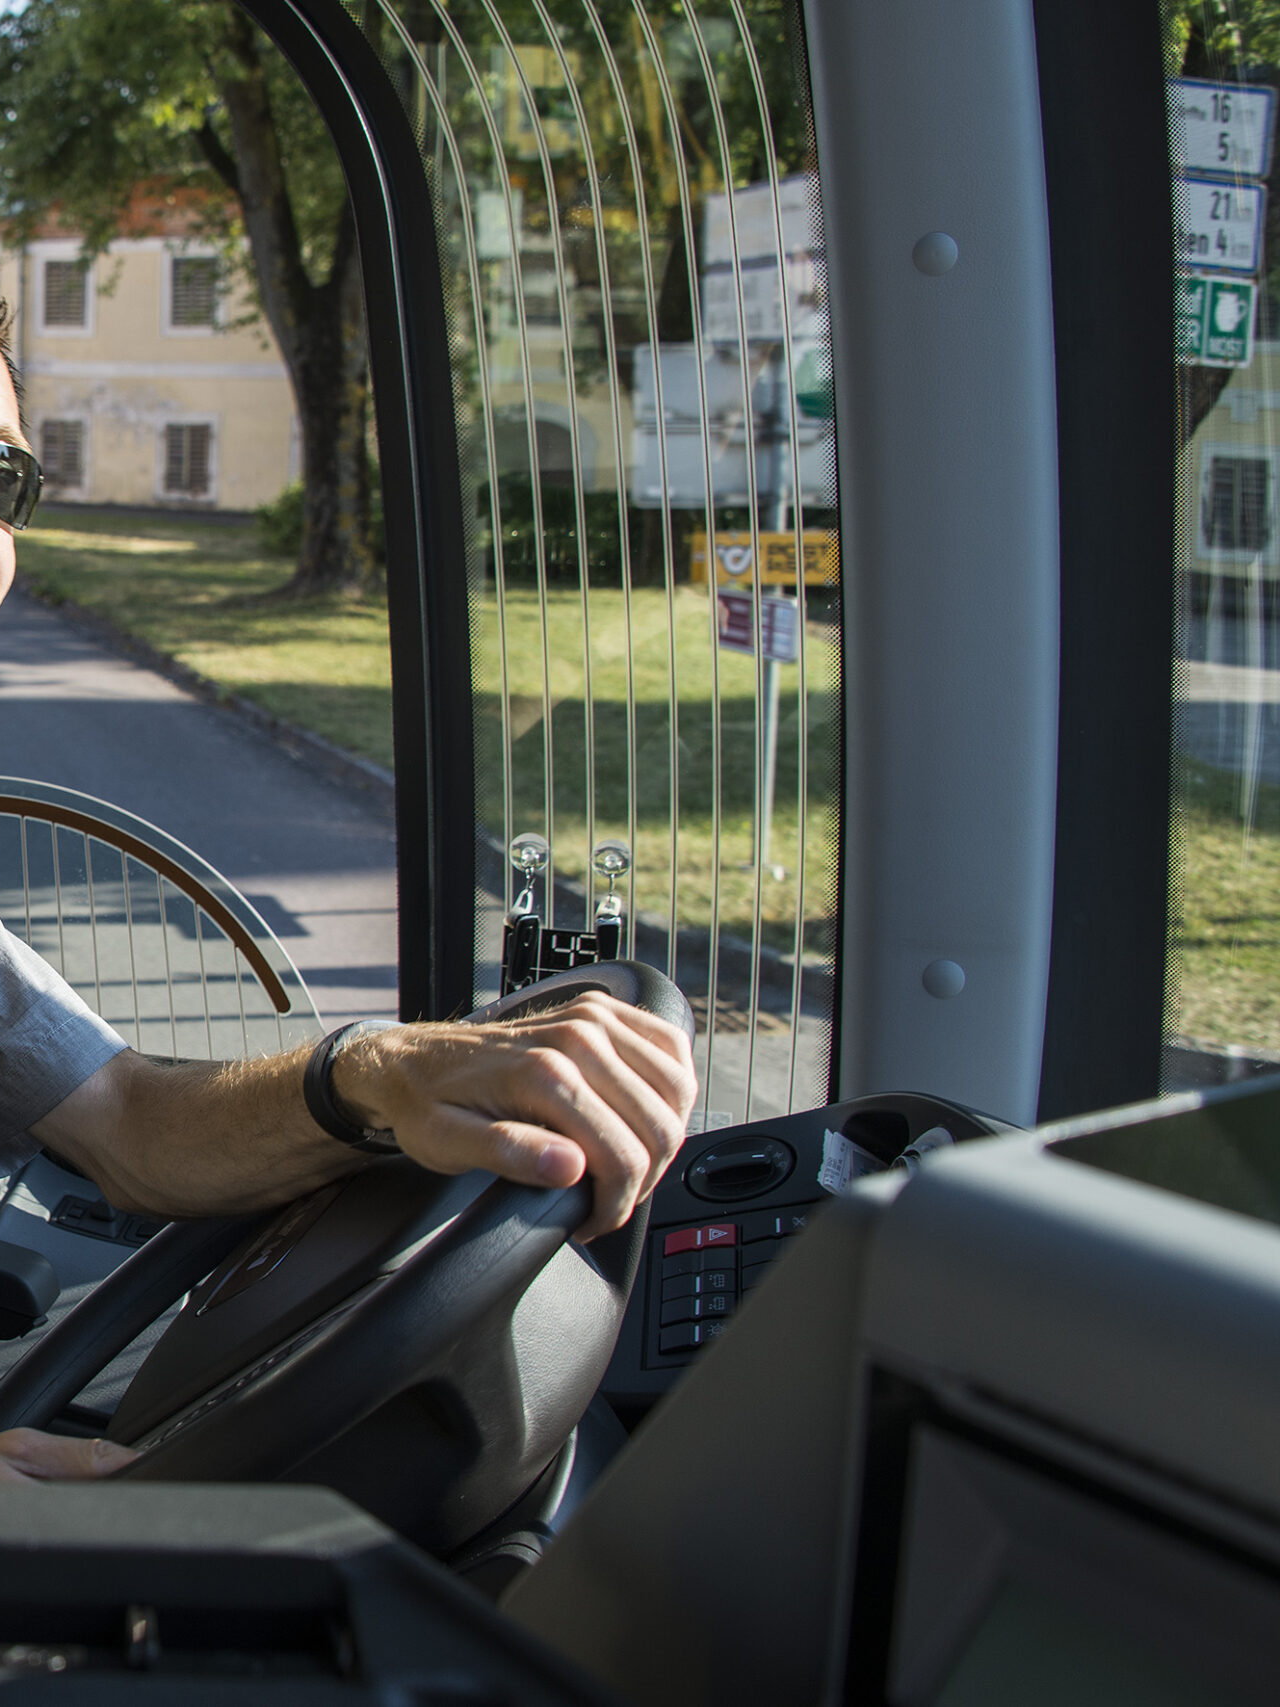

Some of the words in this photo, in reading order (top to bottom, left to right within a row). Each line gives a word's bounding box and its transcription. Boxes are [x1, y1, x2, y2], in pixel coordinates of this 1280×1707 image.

[1211, 93, 1232, 123] 16
[1218, 131, 1230, 161] 5
[1210, 190, 1231, 220] 21
[1215, 228, 1228, 257] 4
